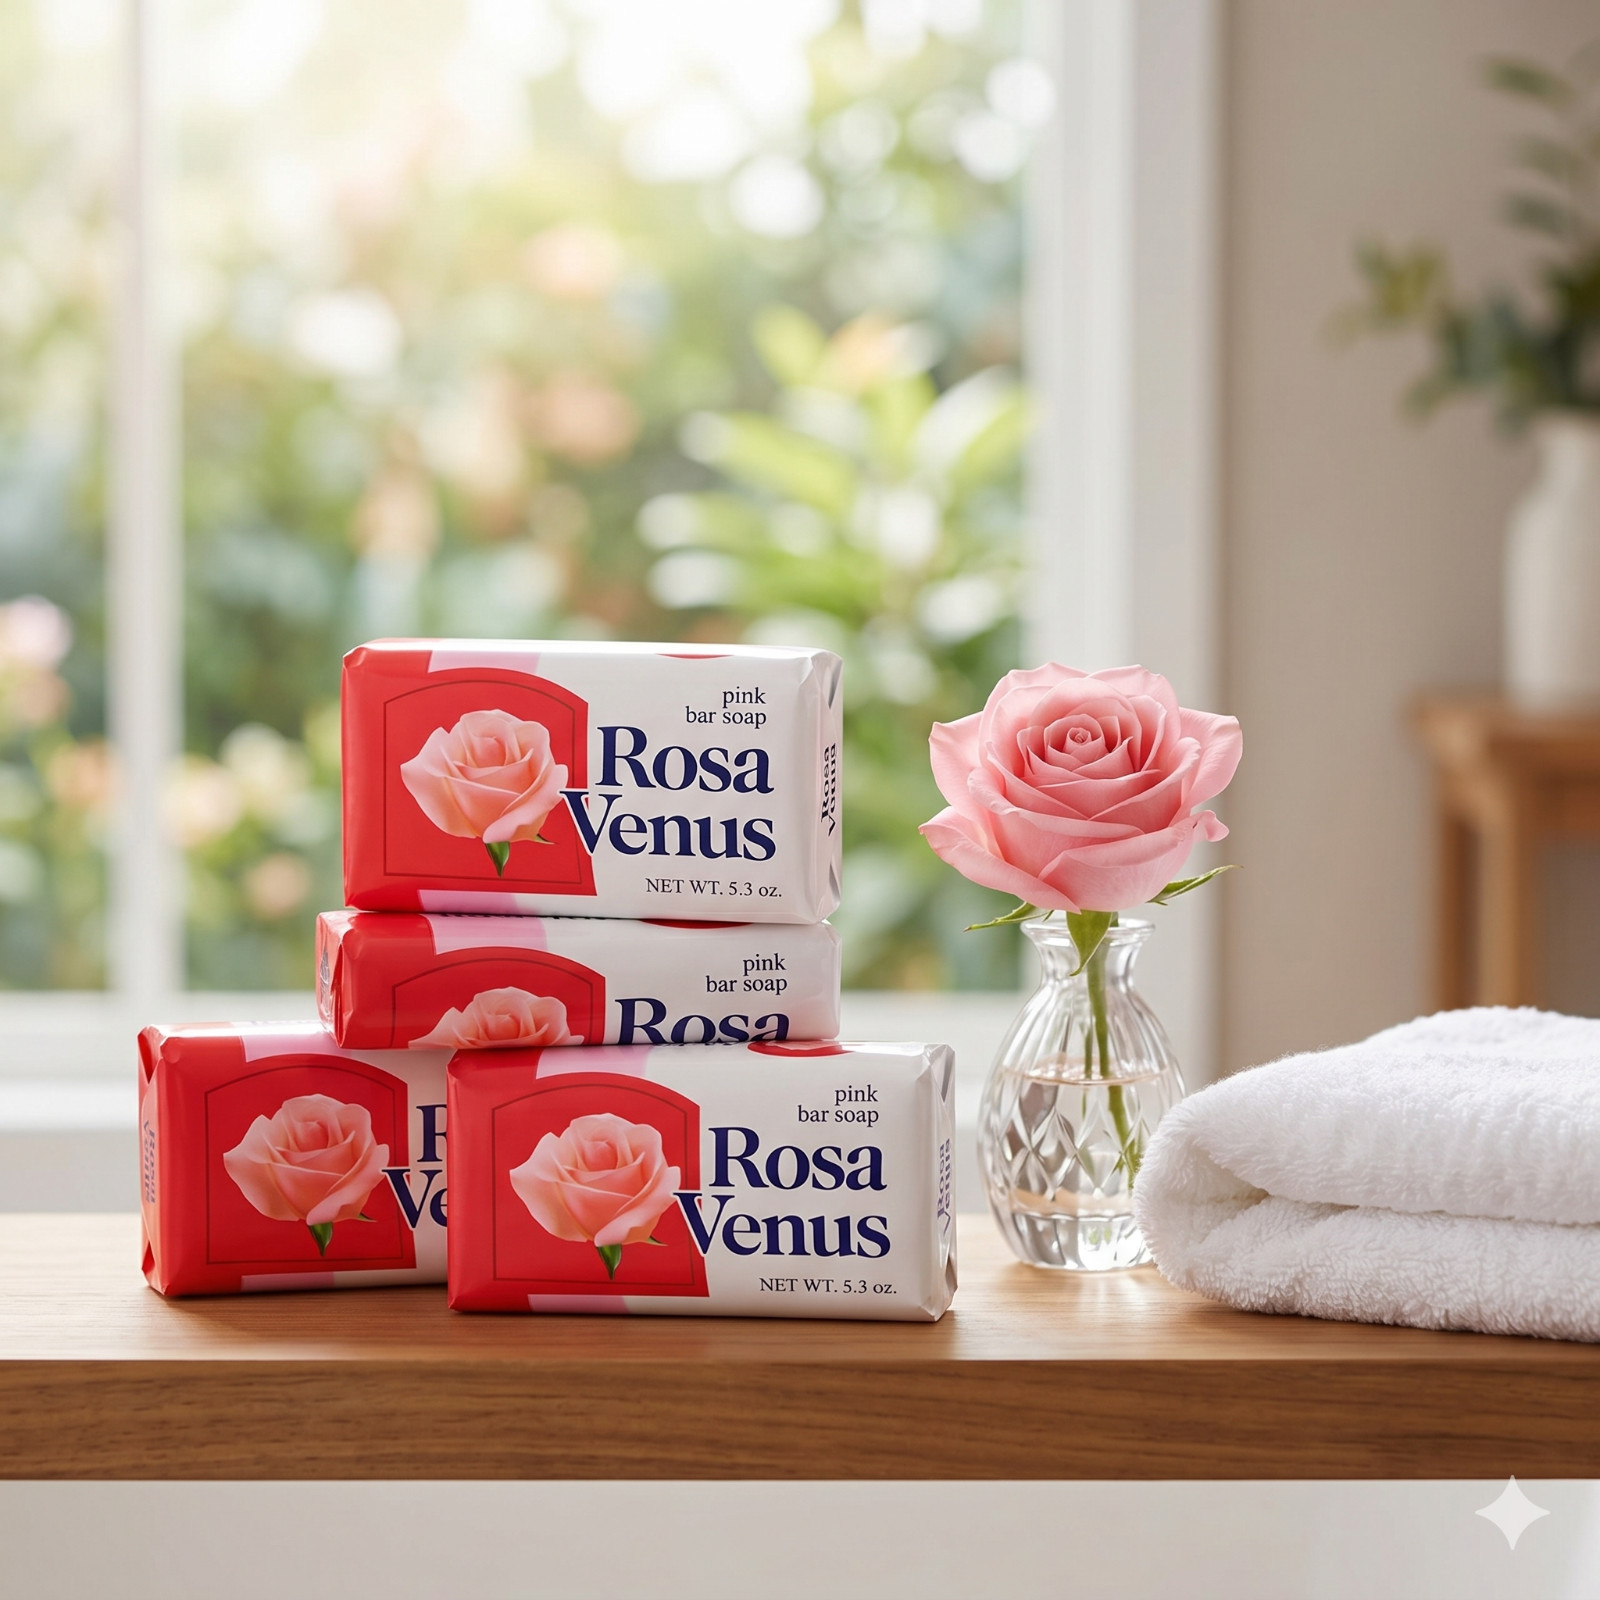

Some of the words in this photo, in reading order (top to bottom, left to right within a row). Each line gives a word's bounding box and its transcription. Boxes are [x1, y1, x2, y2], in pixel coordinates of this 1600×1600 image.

[722, 686, 767, 709] pink
[685, 706, 717, 723] bar
[722, 711, 767, 729] soap
[595, 725, 775, 794] Rosa
[560, 790, 777, 861] Venus
[645, 878, 685, 892] NET
[689, 879, 724, 895] WT.
[728, 881, 753, 896] 5.3
[758, 885, 783, 897] oz.
[742, 953, 787, 976] pink
[705, 975, 738, 992] bar
[743, 978, 788, 995] soap
[615, 998, 790, 1045] Rosa
[834, 1084, 879, 1106] pink
[798, 1105, 830, 1122] bar
[834, 1109, 879, 1127] soap
[709, 1126, 888, 1192] Rosa
[673, 1190, 891, 1258] Venus
[760, 1277, 799, 1292] NET
[802, 1279, 838, 1293] WT.
[842, 1280, 868, 1294] 5.3
[872, 1283, 898, 1295] oz.
